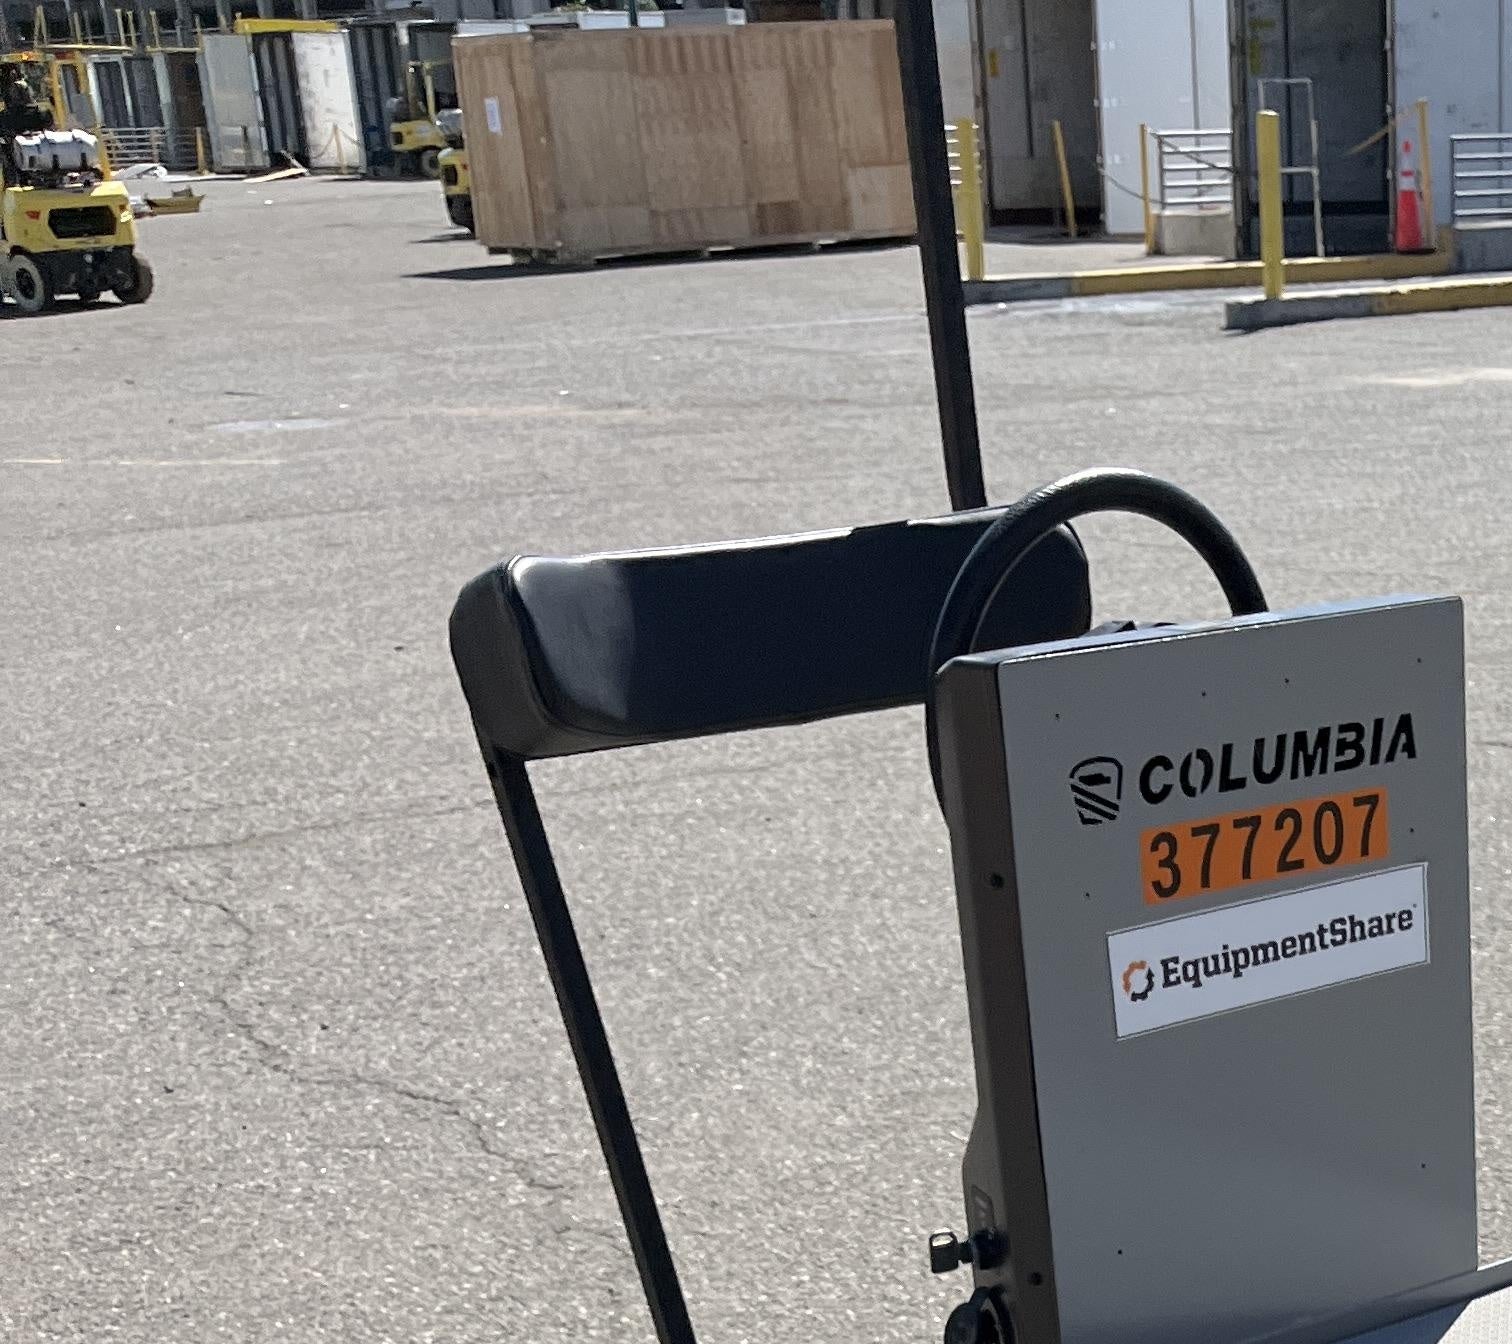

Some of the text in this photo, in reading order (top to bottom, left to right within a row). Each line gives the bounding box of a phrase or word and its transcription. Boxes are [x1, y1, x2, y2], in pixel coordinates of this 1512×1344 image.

[1139, 713, 1416, 804] COLUMBIA
[1149, 794, 1381, 899] 377207
[1160, 907, 1414, 988] EquipmentShare
